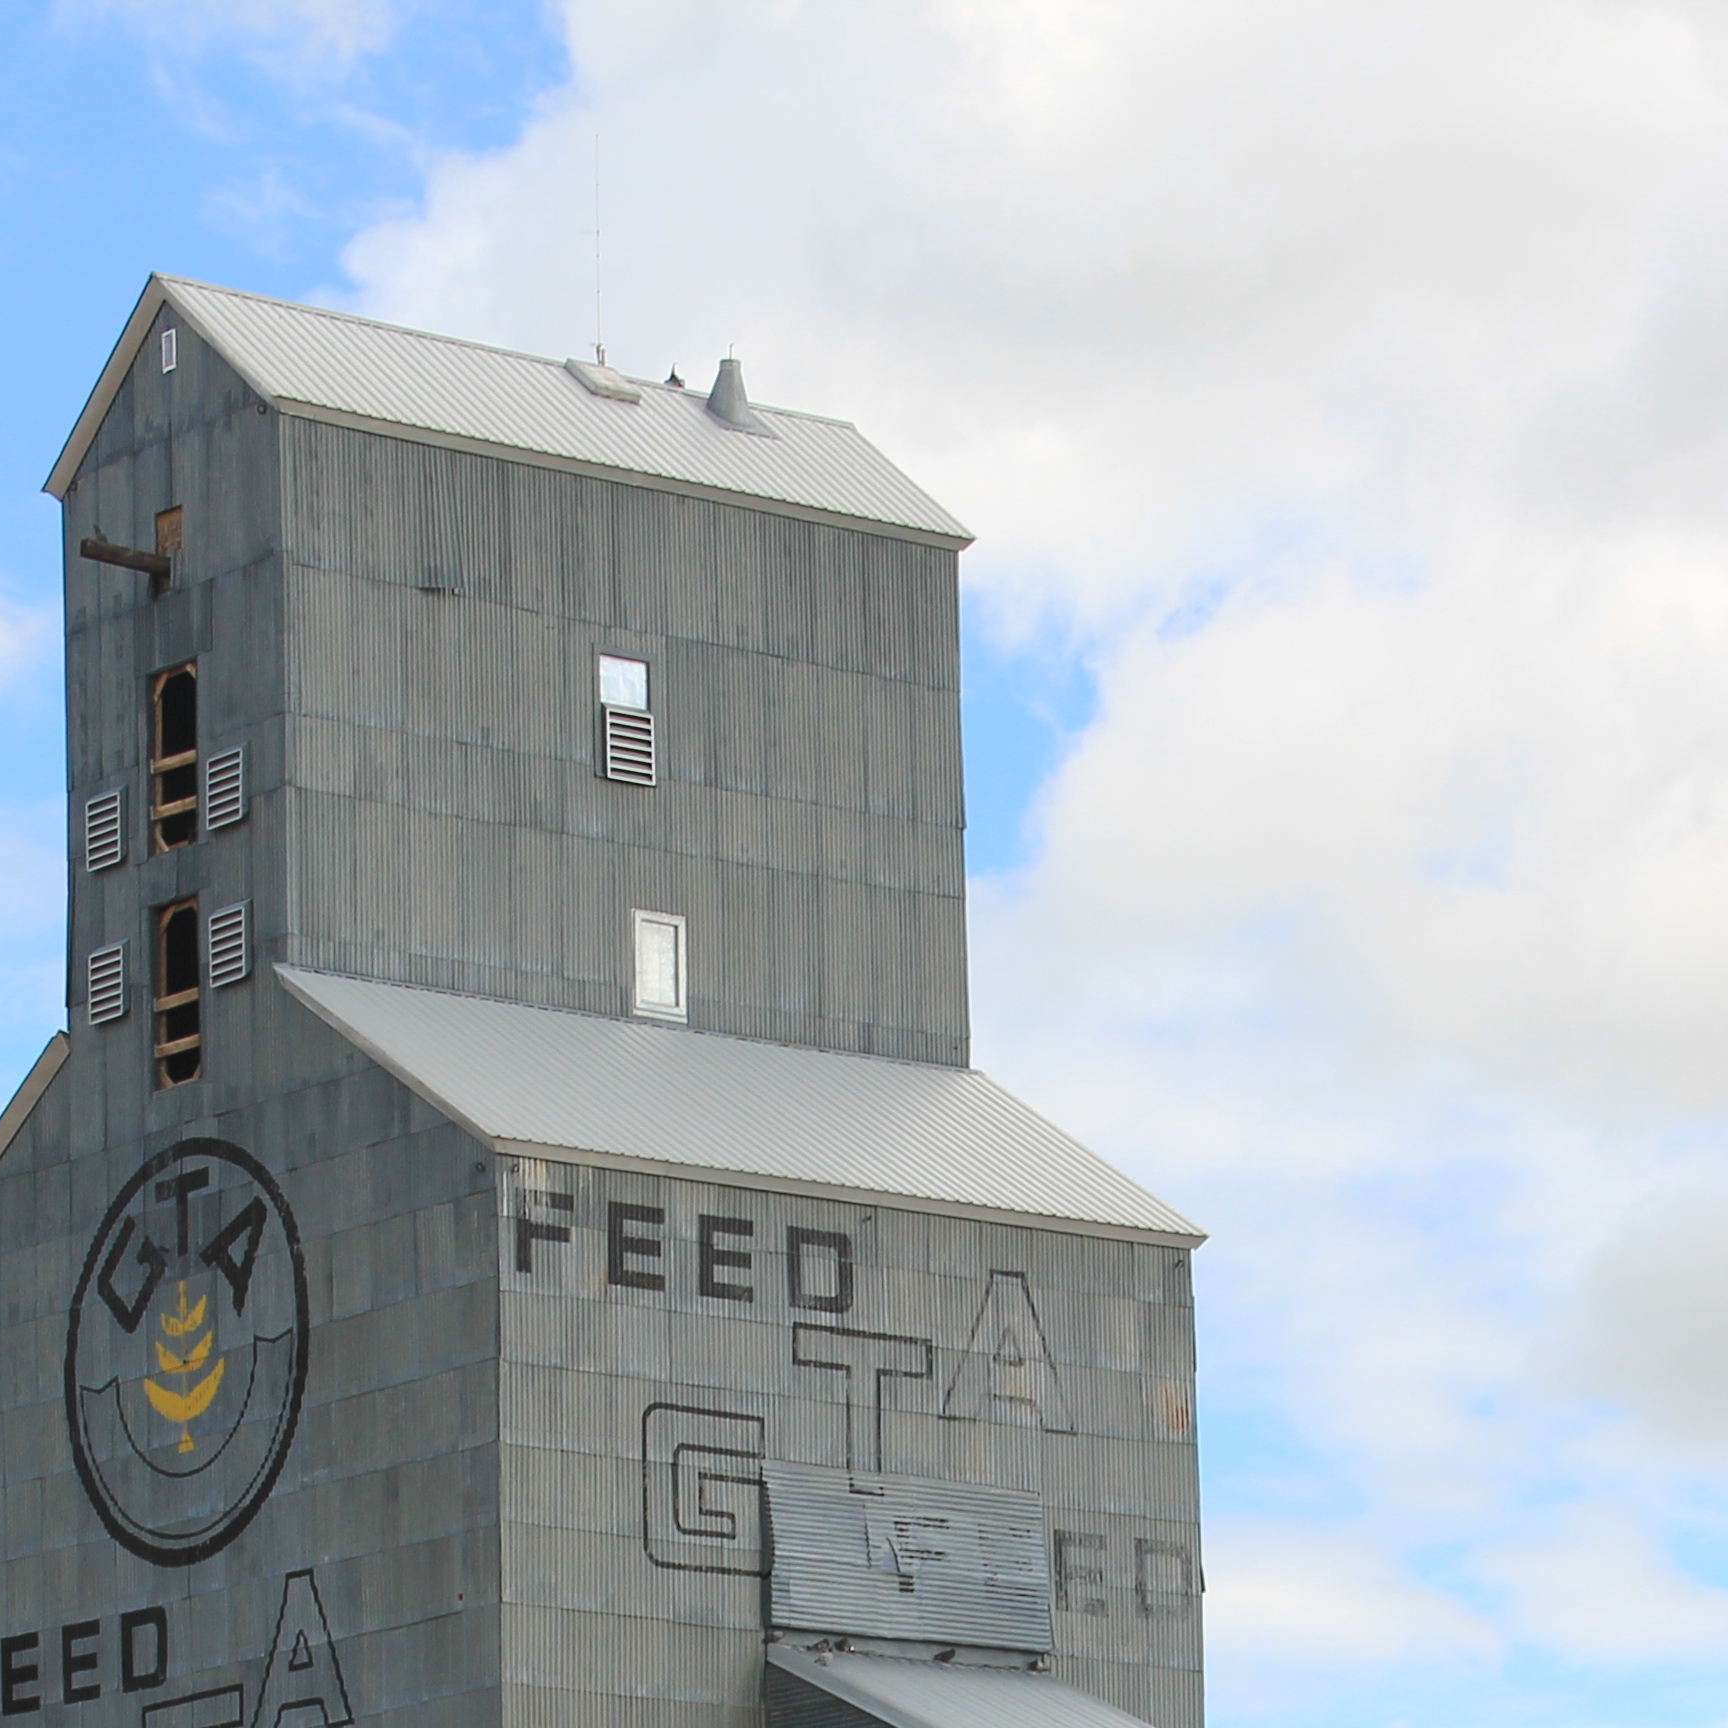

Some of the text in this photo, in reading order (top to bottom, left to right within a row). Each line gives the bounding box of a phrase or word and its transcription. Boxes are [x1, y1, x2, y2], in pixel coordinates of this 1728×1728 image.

[97, 1167, 268, 1334] GTA
[515, 1191, 855, 1314] FEED
[642, 1268, 1078, 1581] GTA
